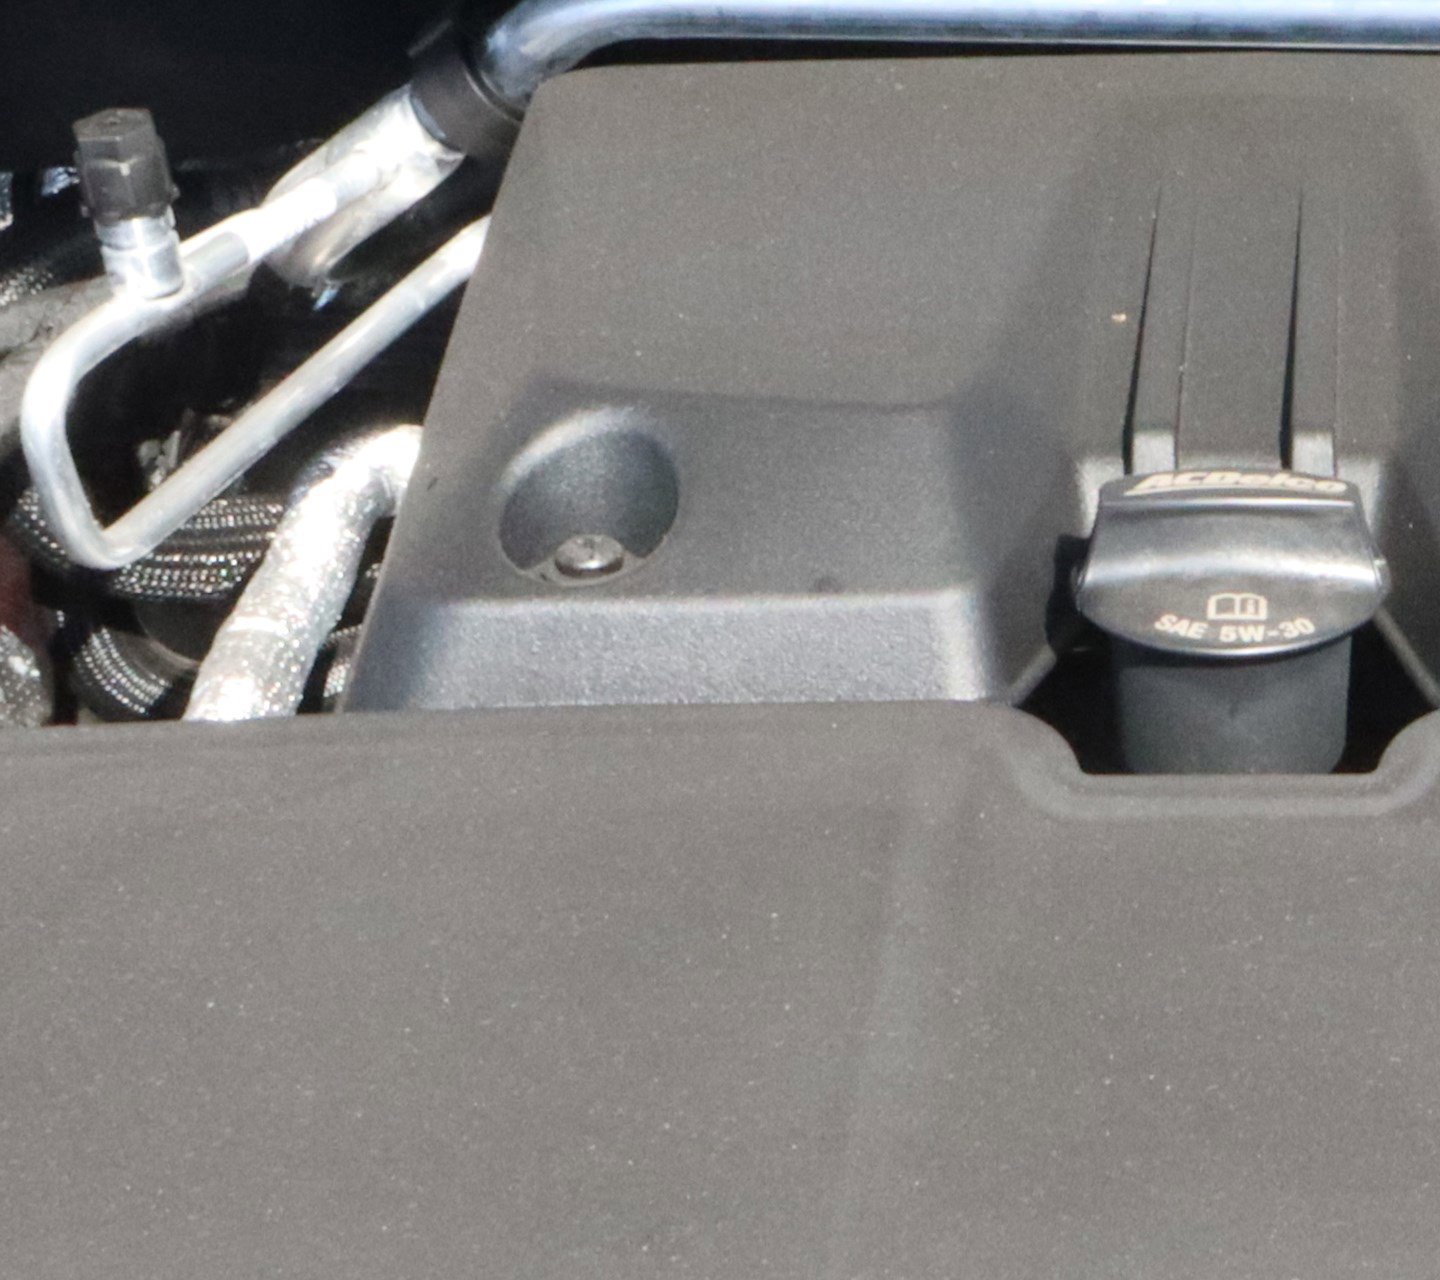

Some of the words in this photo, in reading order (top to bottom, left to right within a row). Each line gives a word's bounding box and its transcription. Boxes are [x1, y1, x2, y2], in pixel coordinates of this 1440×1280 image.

[1123, 471, 1349, 497] ACDelco
[1154, 614, 1208, 641] SAE
[1219, 616, 1316, 643] 5W-30
